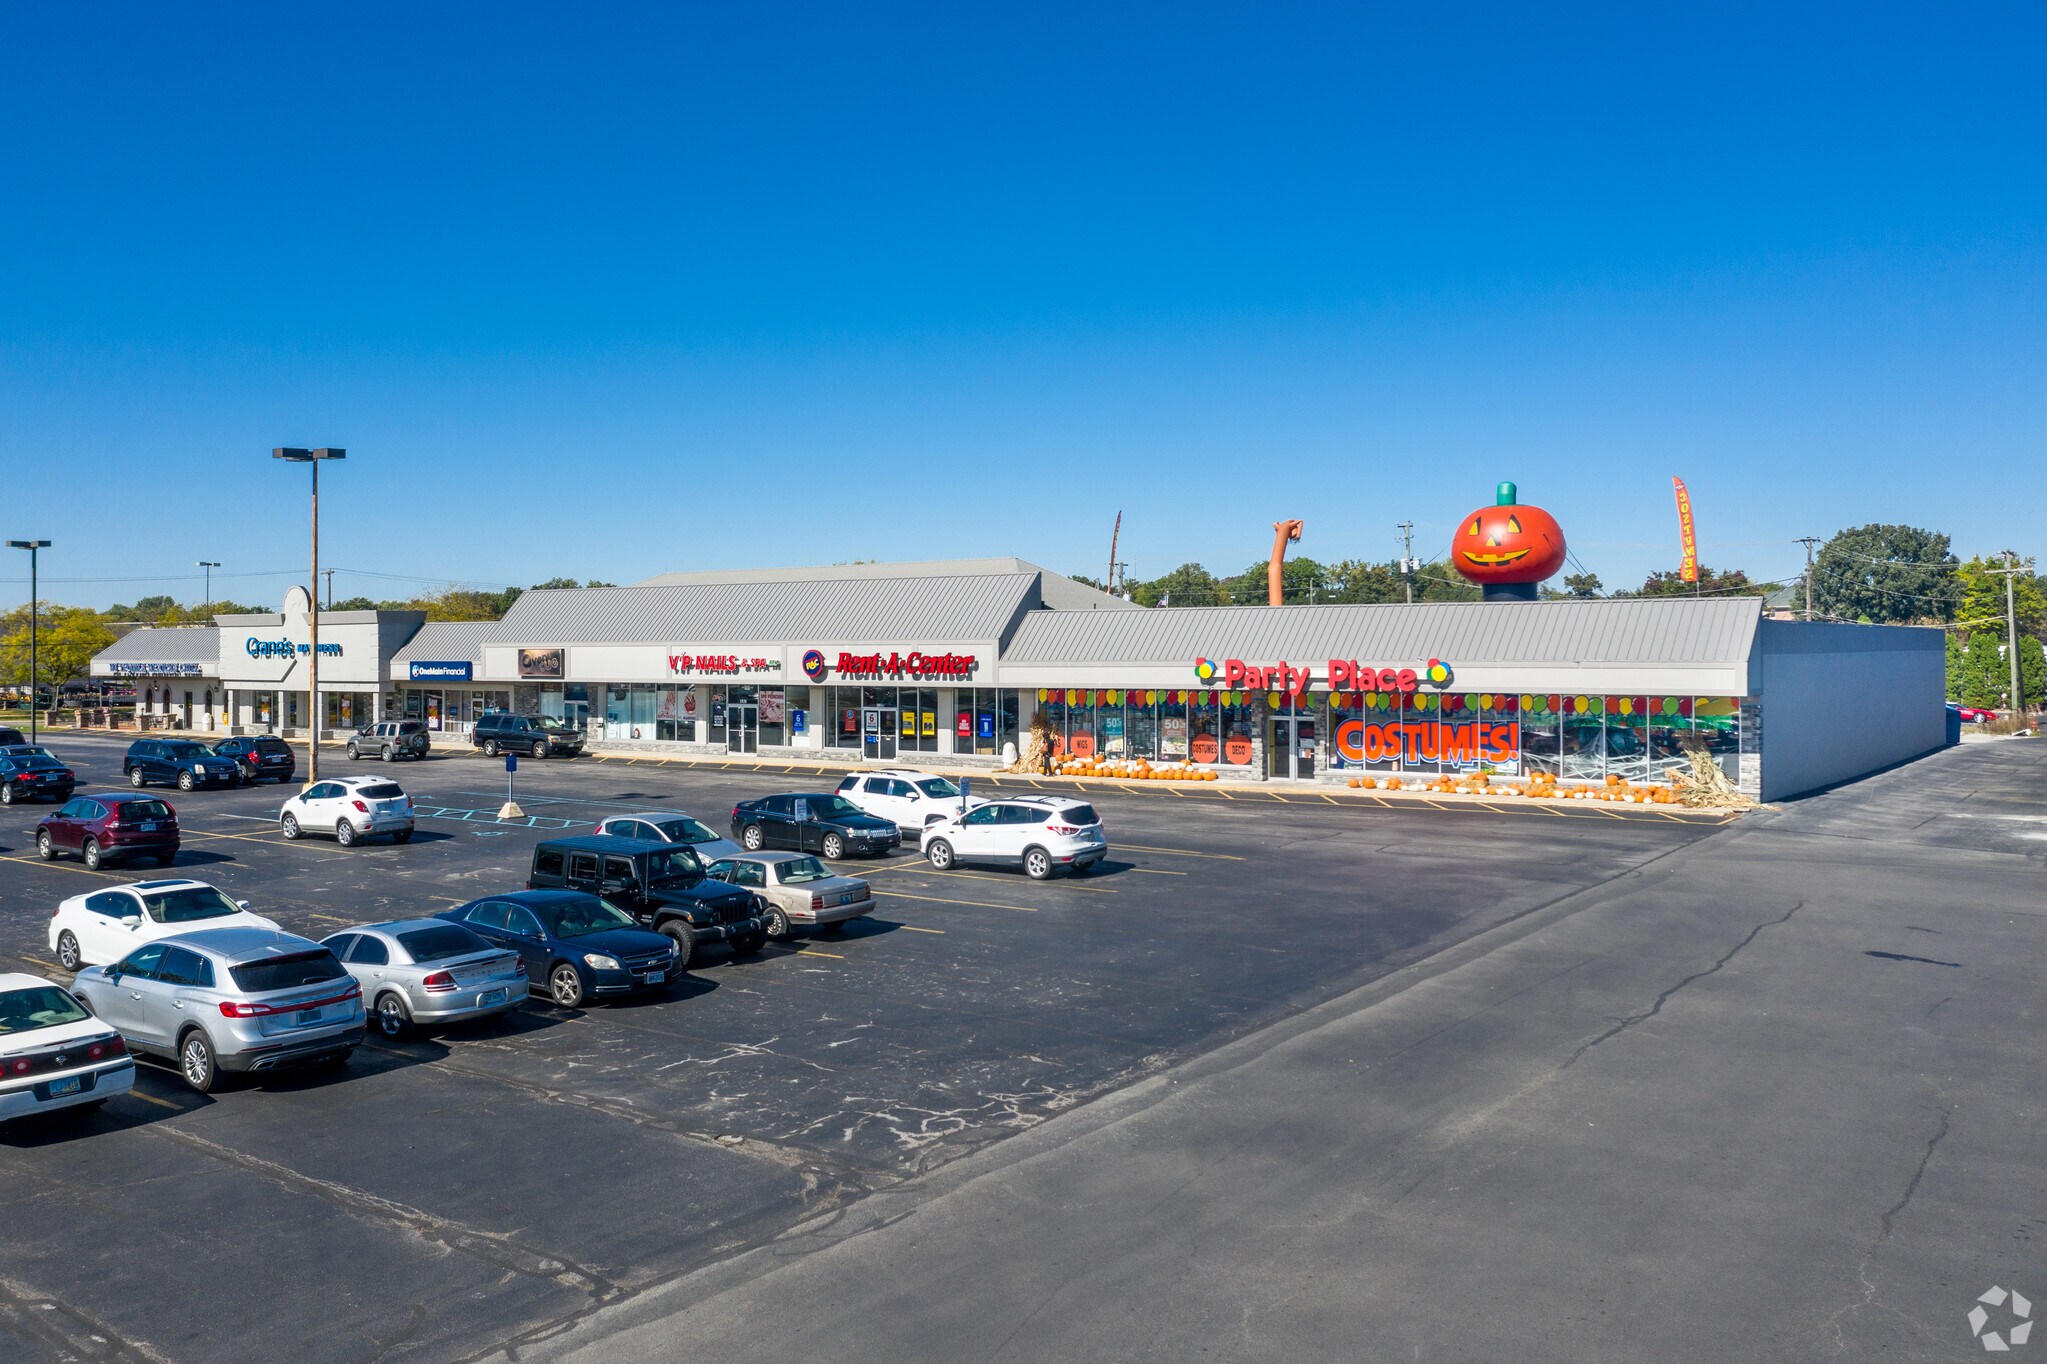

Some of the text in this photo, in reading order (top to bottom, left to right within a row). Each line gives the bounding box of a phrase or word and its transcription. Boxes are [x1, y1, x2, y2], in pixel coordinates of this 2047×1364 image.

[246, 636, 293, 655] Crane's
[695, 655, 736, 671] NAILS
[741, 658, 748, 668] &
[750, 658, 767, 667] SPA
[1225, 659, 1417, 697] Party Place
[1232, 744, 1246, 755] DECO
[1335, 718, 1520, 766] COSTUMES!
